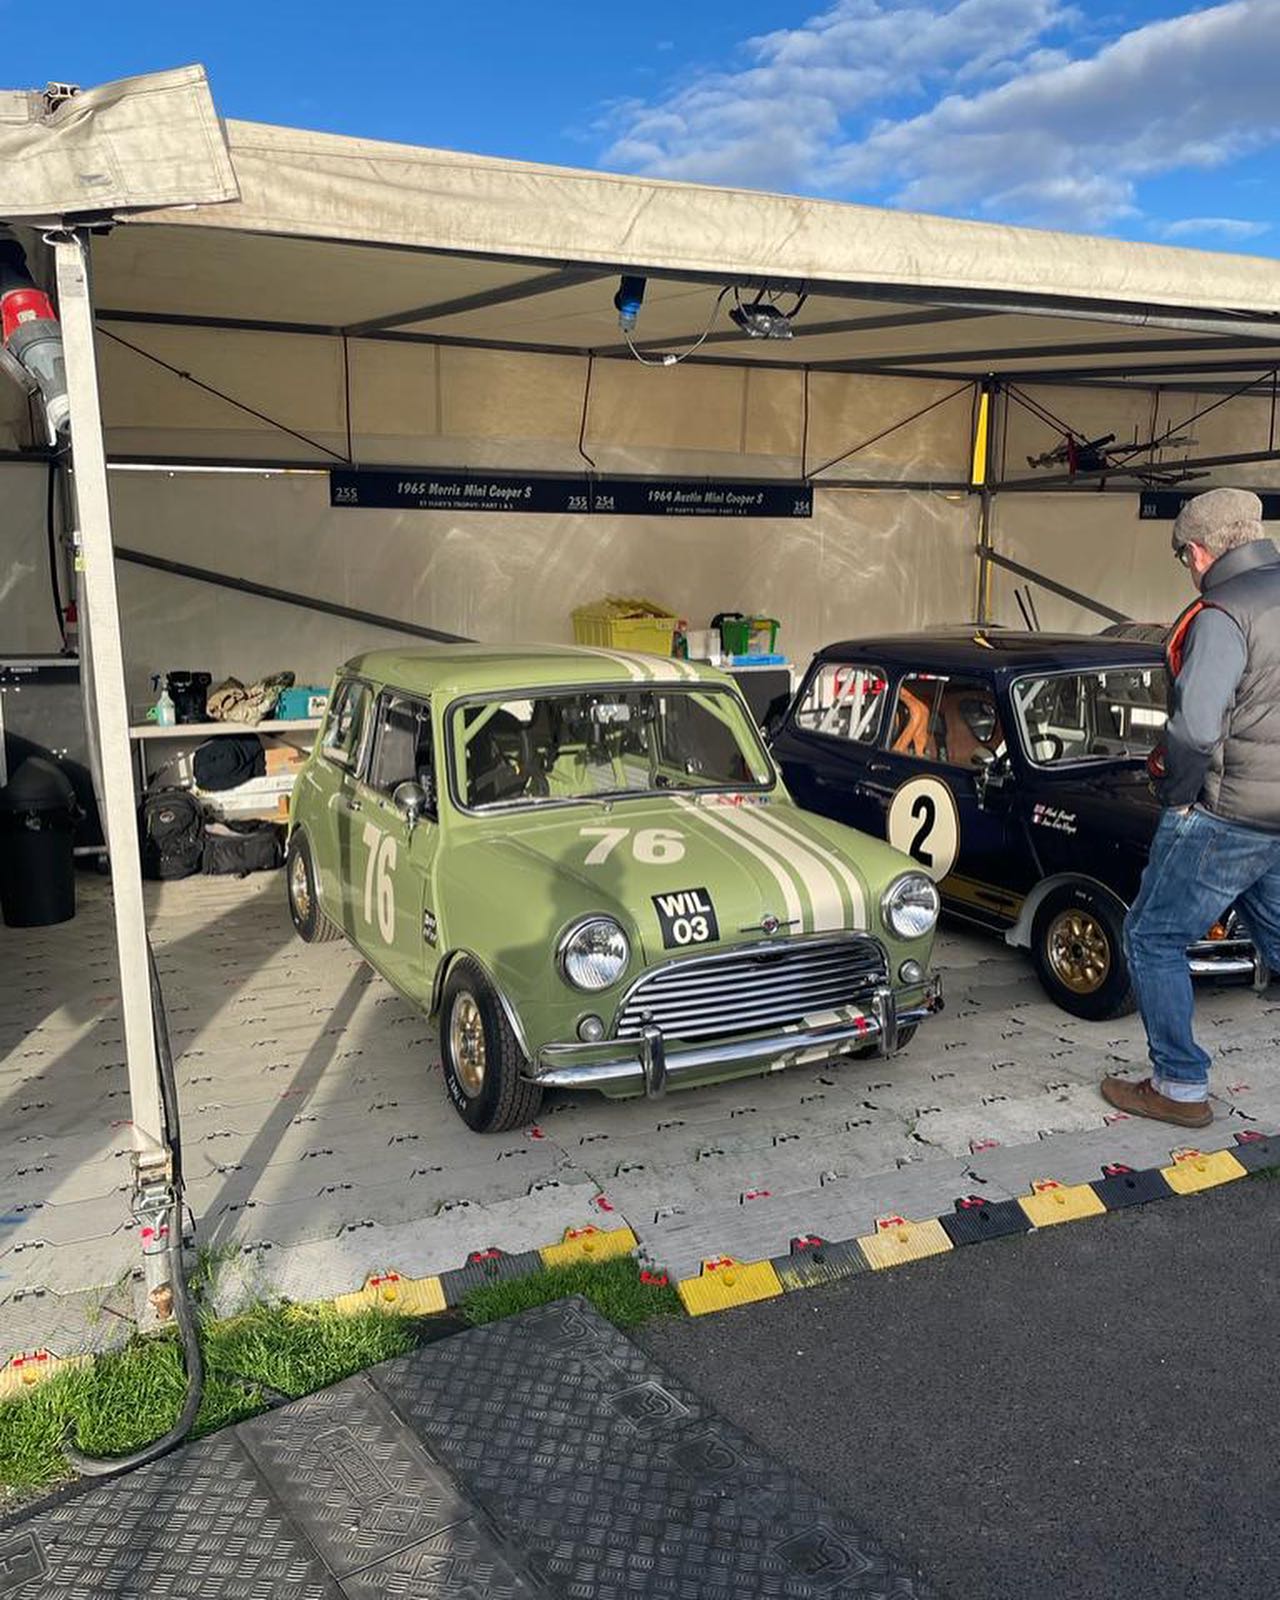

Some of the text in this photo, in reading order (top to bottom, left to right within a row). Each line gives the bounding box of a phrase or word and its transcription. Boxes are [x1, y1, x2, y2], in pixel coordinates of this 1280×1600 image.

[335, 487, 357, 497] 255
[397, 482, 532, 500] 1965 Morris Mini Cooper S
[648, 490, 673, 502] 1964
[673, 491, 702, 503] Austin
[726, 492, 756, 507] Cooper
[756, 492, 764, 504] S
[909, 794, 936, 867] 2
[579, 827, 686, 865] 76
[363, 821, 397, 944] 76
[657, 892, 711, 917] WIL
[672, 916, 709, 945] 03
